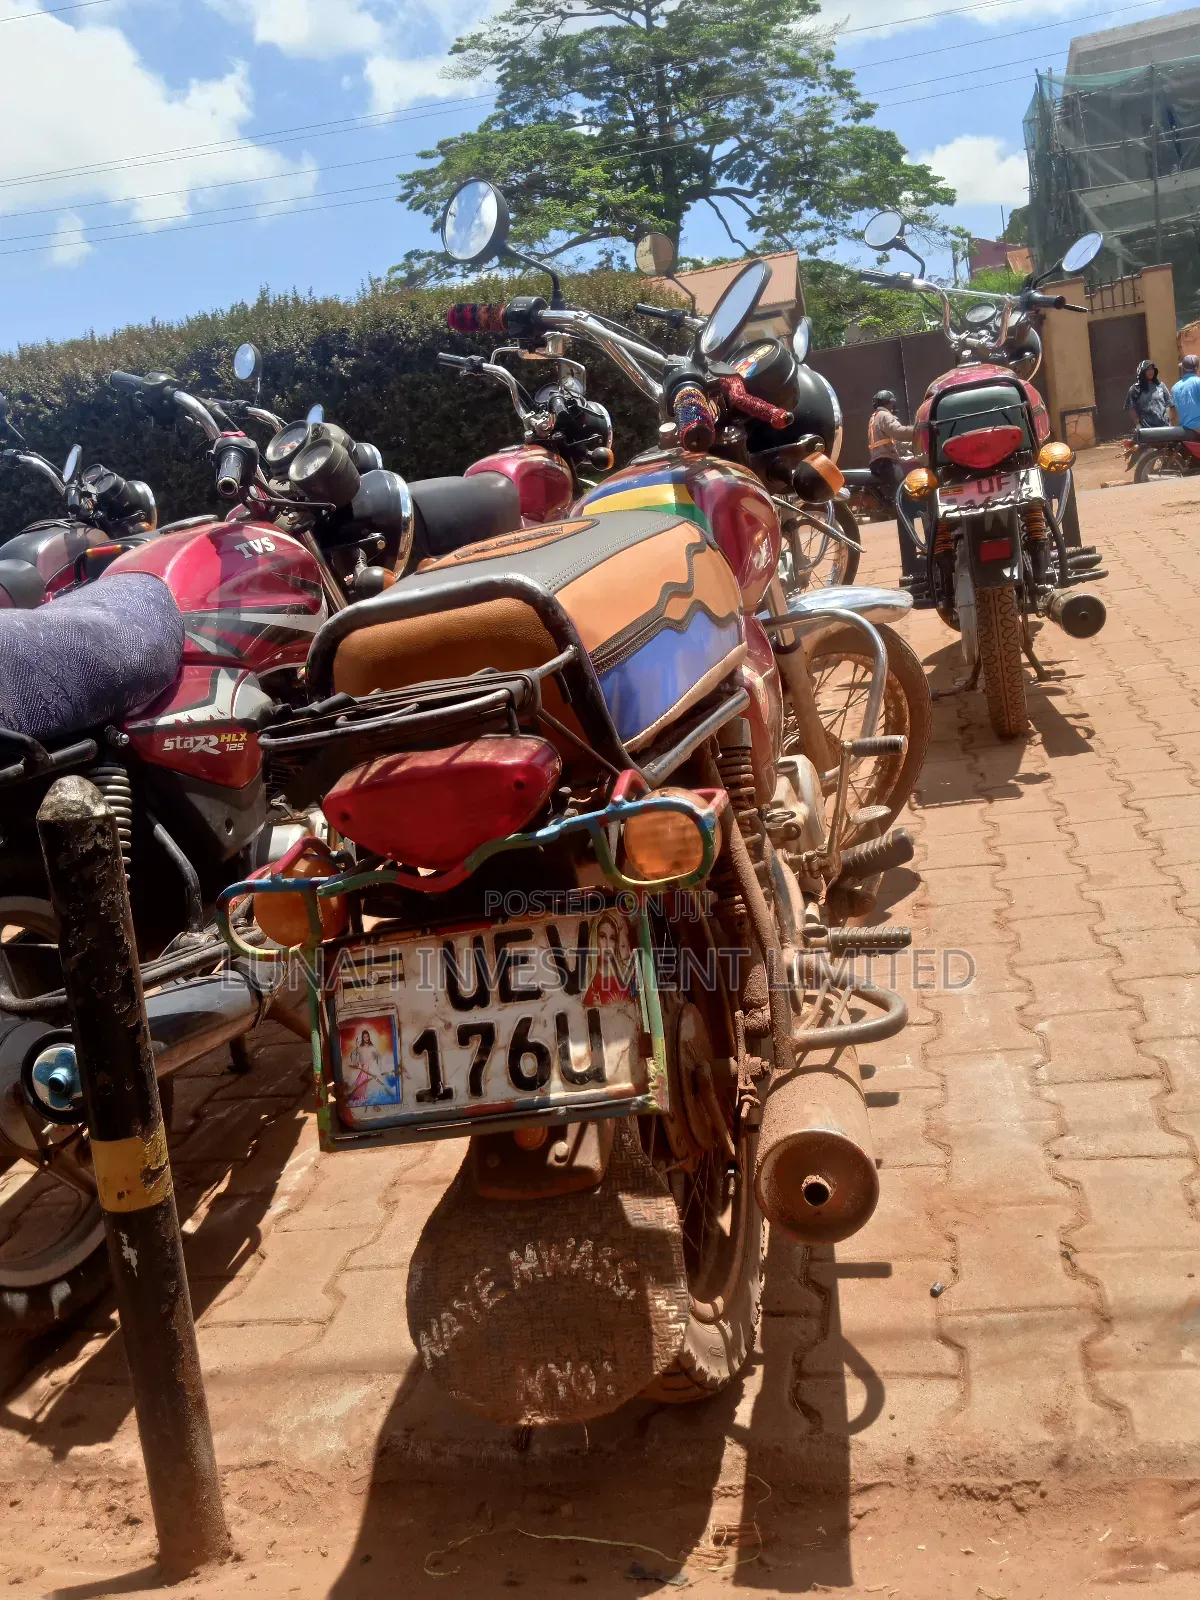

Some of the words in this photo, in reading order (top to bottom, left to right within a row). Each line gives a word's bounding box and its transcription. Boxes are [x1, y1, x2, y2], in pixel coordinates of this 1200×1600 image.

[234, 536, 276, 559] TVS
[220, 731, 248, 743] HLX
[225, 742, 245, 752] 125
[441, 920, 590, 1012] UEV
[412, 1007, 608, 1103] 176U
